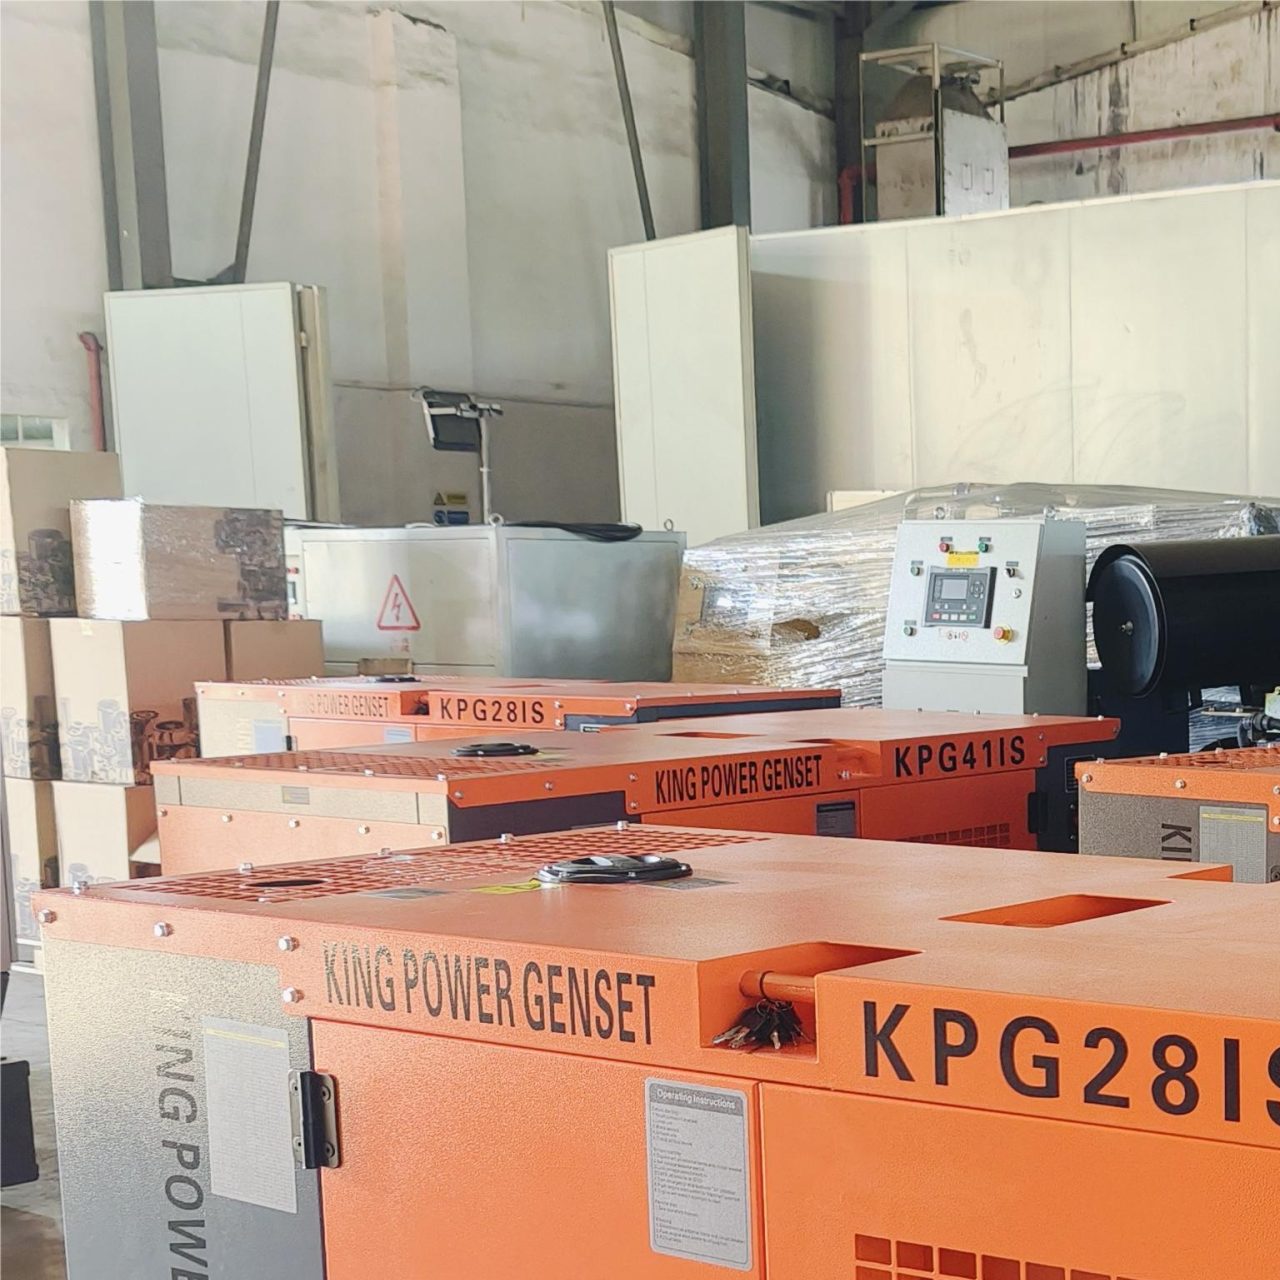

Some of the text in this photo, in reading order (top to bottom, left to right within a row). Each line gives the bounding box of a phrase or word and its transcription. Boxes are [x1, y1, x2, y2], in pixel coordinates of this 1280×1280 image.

[352, 695, 389, 718] GENSET
[440, 697, 545, 724] KPG28IS
[894, 735, 1026, 778] KPG41IS
[655, 754, 823, 804] KING POWER GENSET
[323, 939, 656, 1045] KING POWER GENSET
[656, 1088, 693, 1104] Operating
